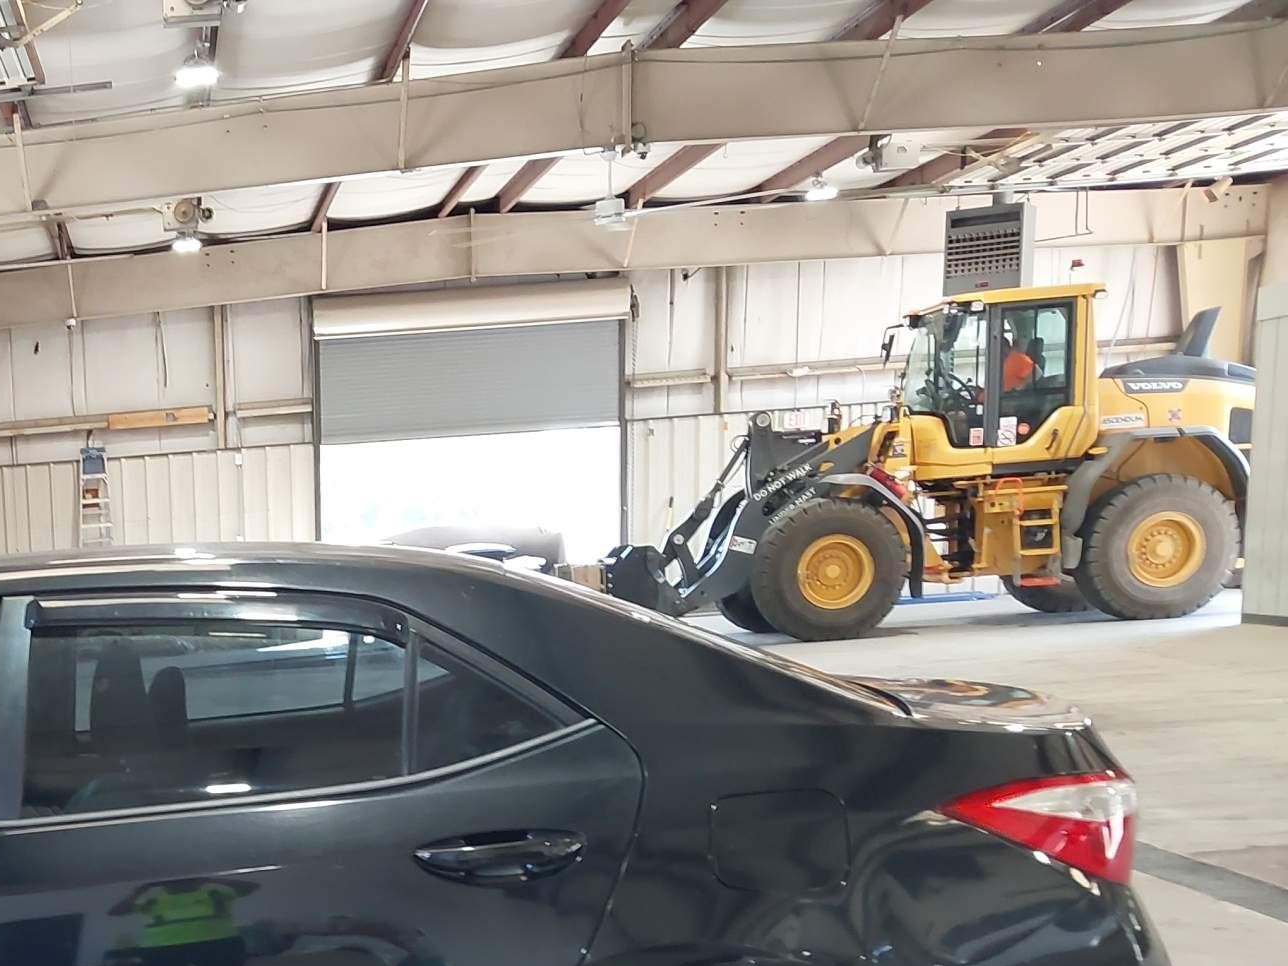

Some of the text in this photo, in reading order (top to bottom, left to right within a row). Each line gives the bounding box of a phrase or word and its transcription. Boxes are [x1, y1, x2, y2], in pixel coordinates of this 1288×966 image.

[1127, 382, 1184, 390] VOLVO
[753, 462, 813, 501] DO NOT WALK
[795, 487, 817, 506] MAST
